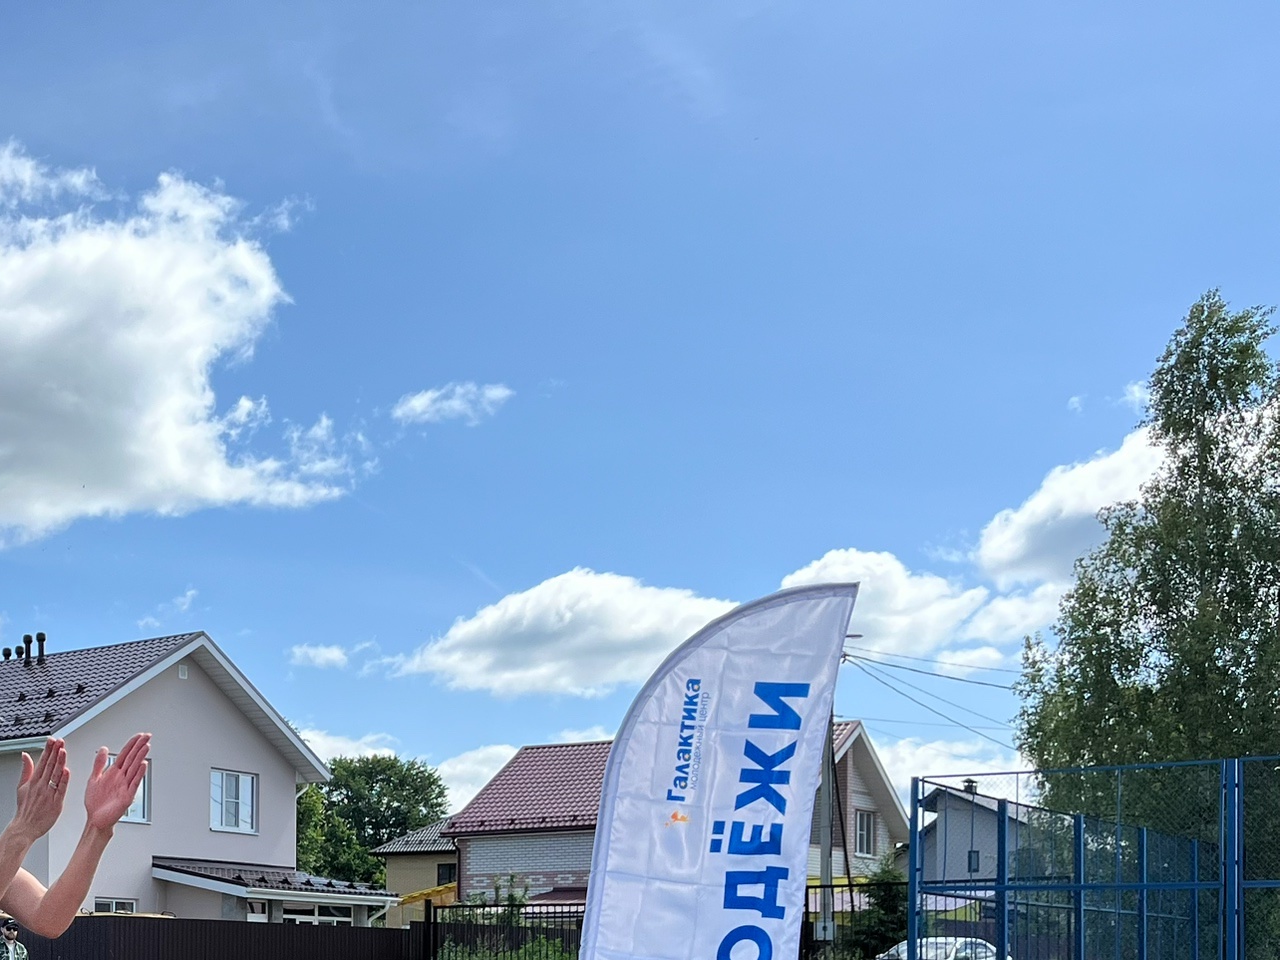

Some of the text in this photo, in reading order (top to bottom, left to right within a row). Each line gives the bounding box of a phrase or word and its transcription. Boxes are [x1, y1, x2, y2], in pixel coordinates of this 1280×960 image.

[666, 678, 701, 802] Галактика
[690, 691, 710, 791] молодежный центр
